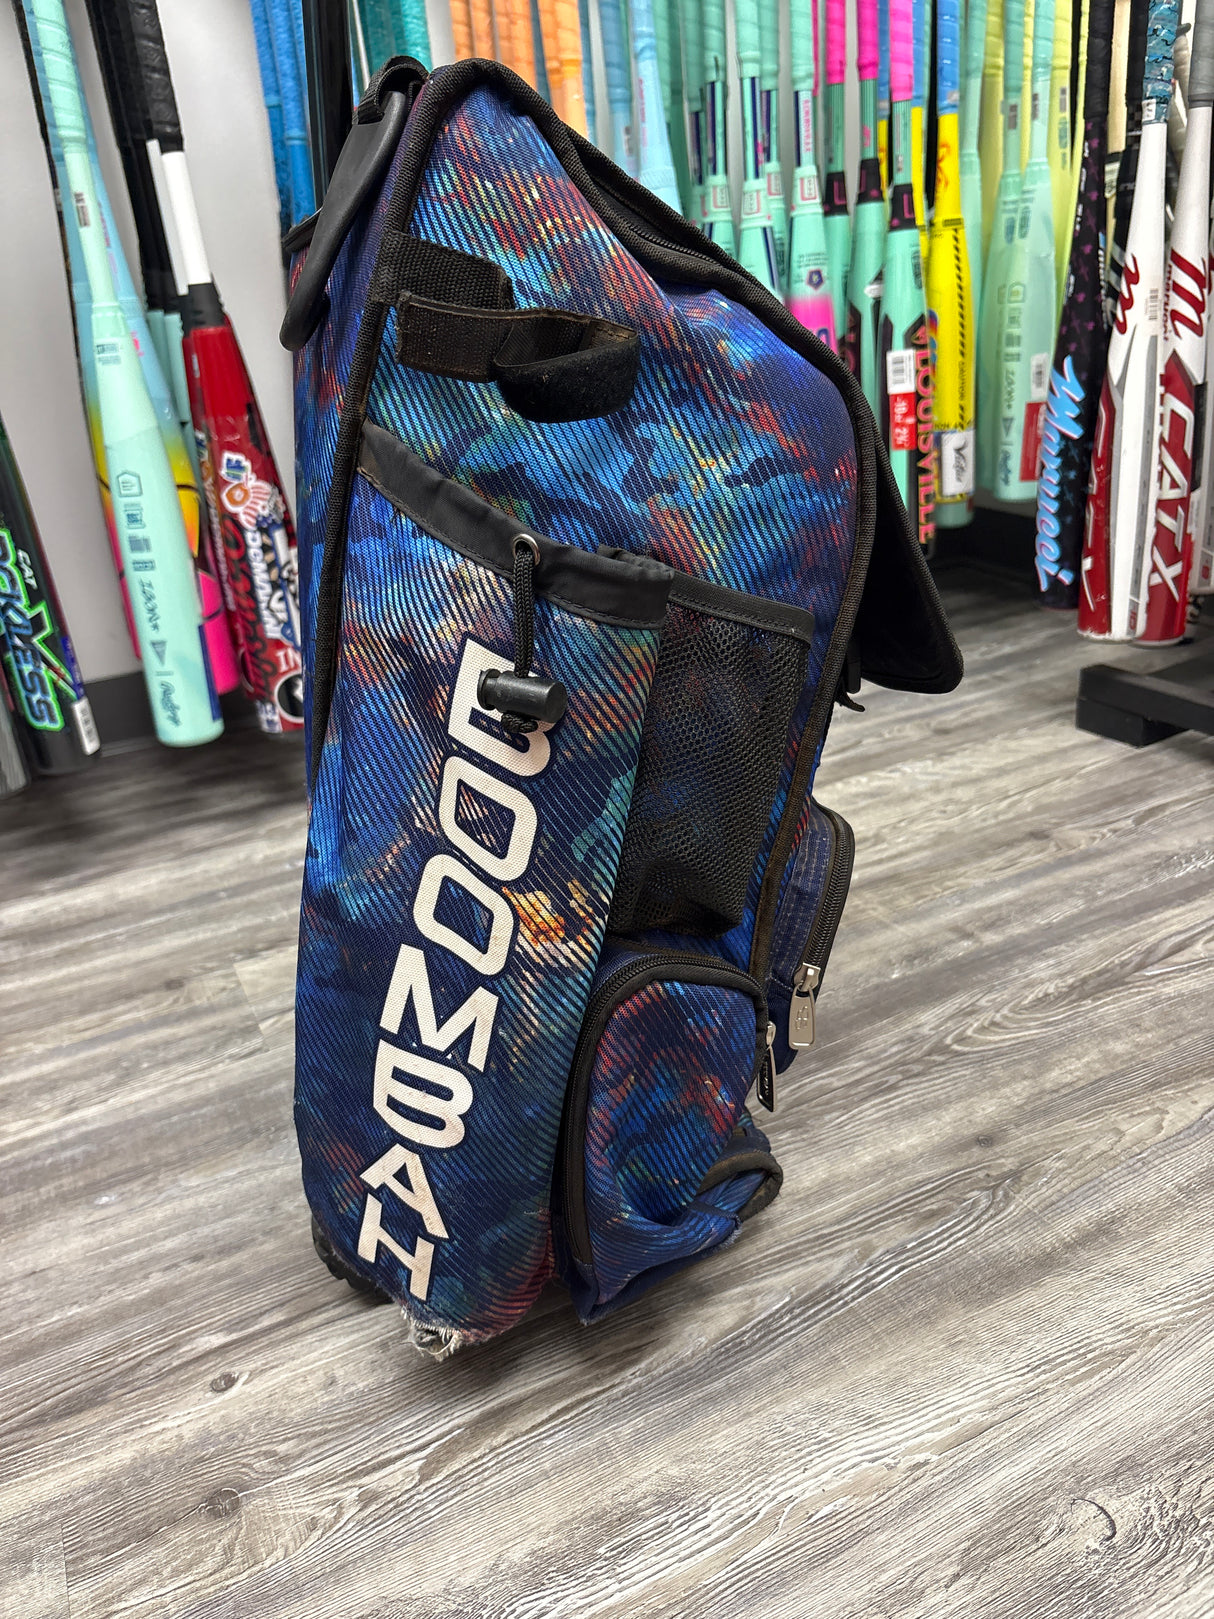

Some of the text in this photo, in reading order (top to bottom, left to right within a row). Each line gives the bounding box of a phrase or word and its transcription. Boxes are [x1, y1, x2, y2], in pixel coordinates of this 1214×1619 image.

[914, 350, 936, 544] LOUISVILLE
[1034, 354, 1086, 593] Marucci
[17, 549, 38, 590] CAT
[357, 638, 551, 1301] BOOMBAH
